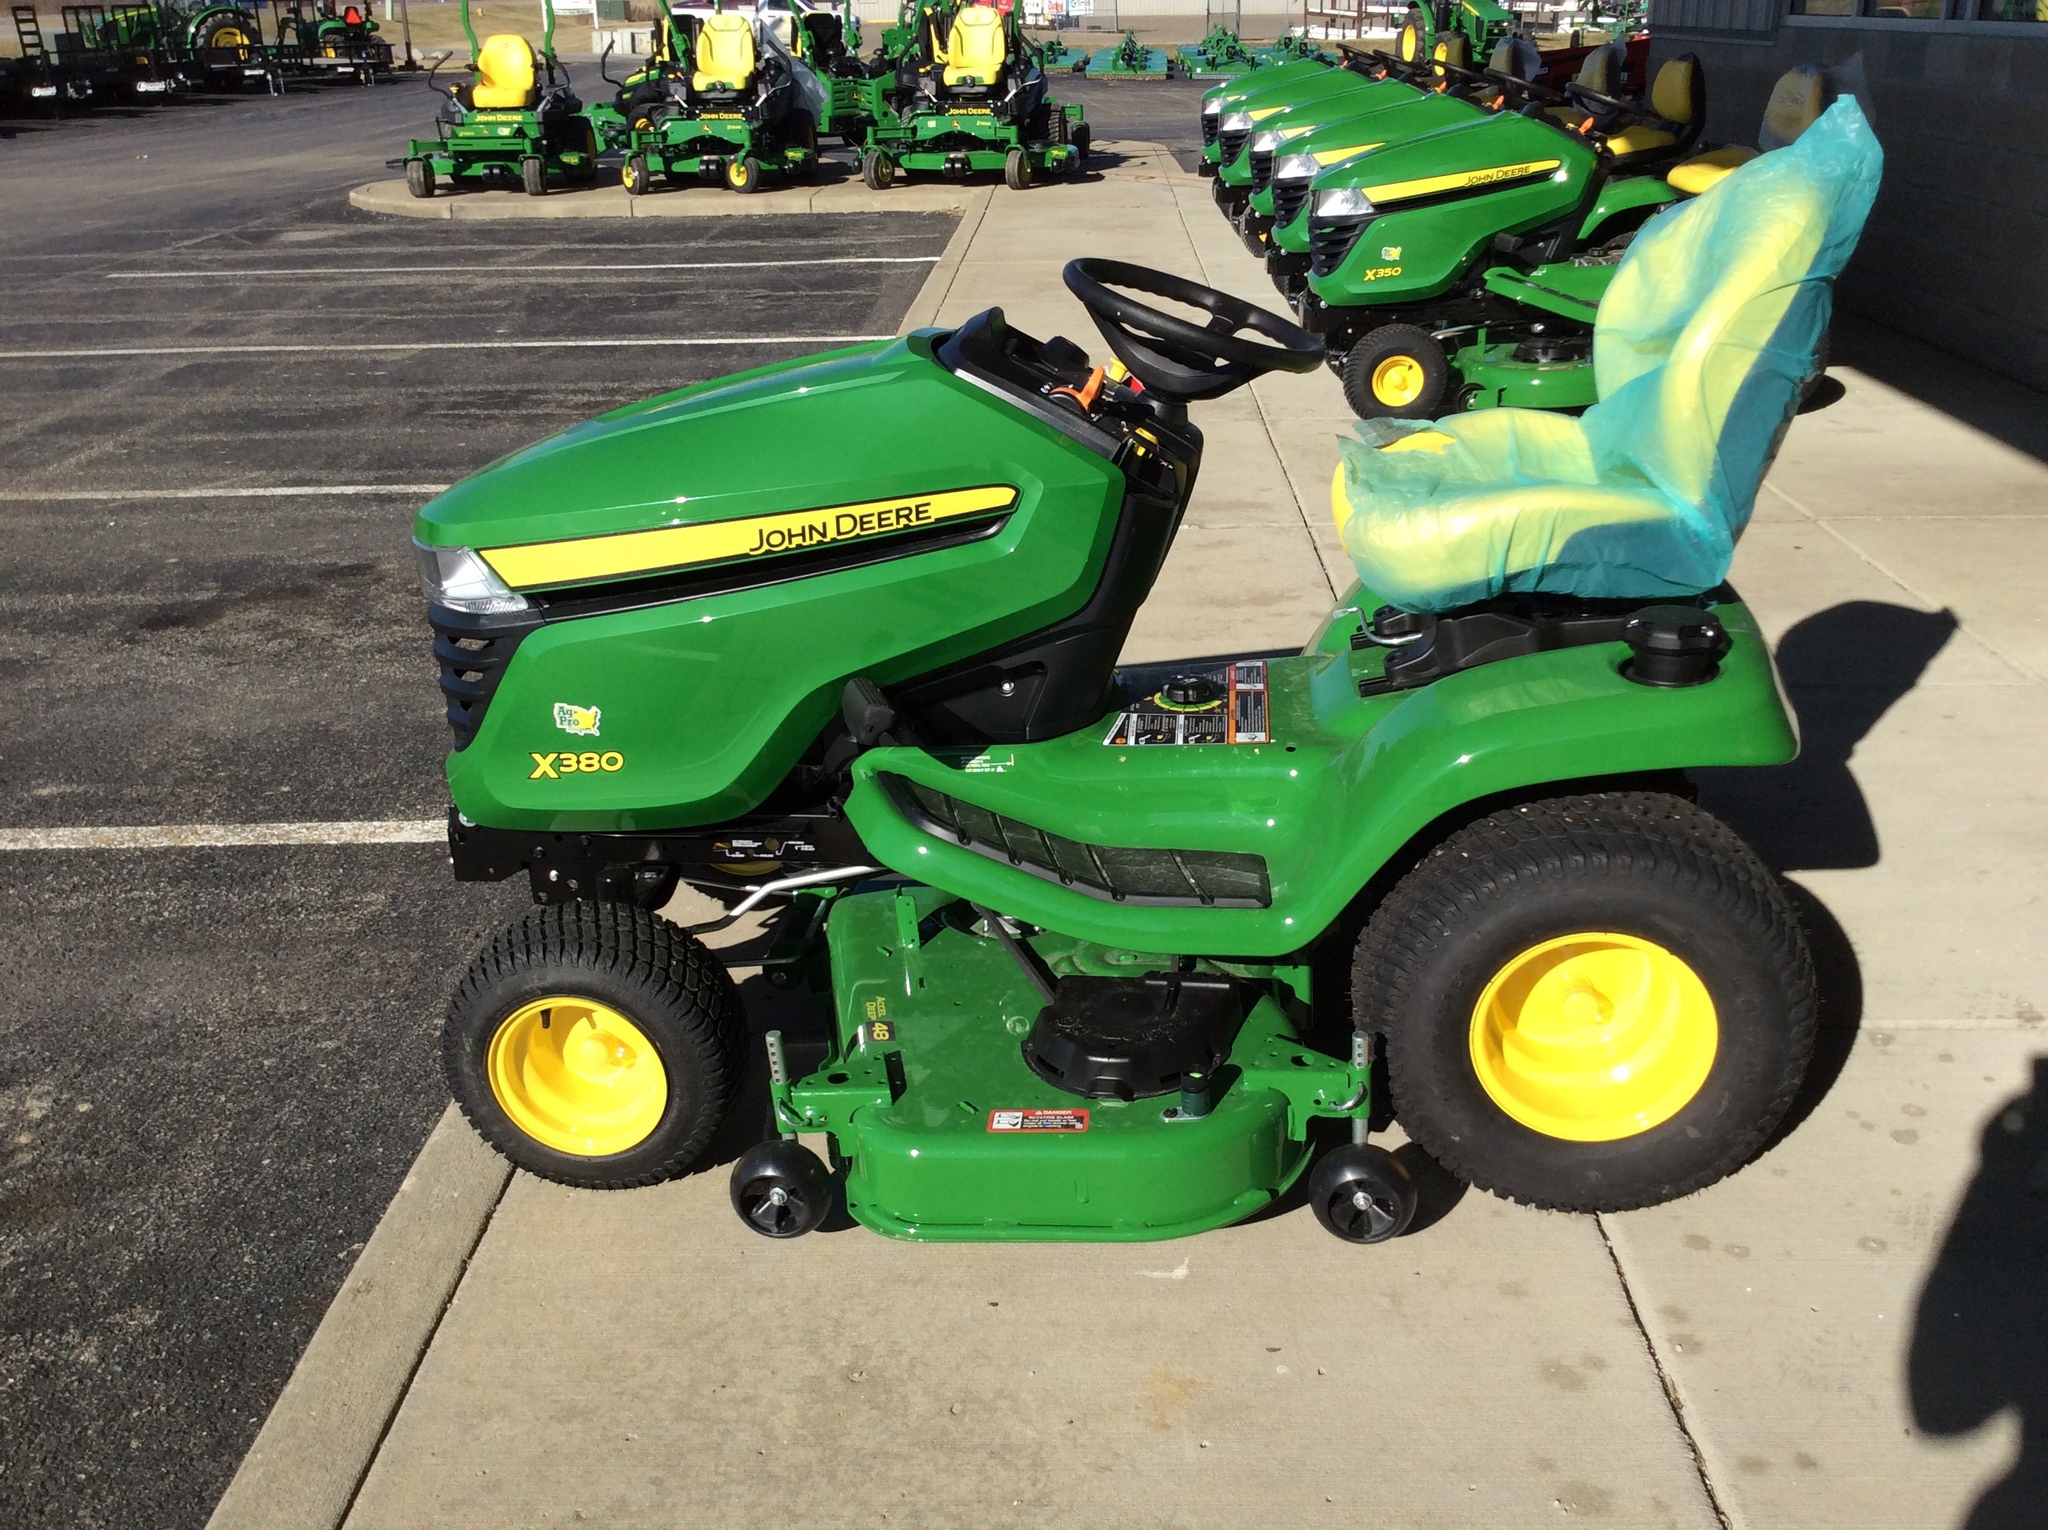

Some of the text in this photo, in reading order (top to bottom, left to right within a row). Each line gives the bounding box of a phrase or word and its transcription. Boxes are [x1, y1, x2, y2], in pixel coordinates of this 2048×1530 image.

[949, 107, 991, 115] JOHN DEERE
[1464, 165, 1531, 186] JOHN DEERE
[1363, 266, 1402, 282] X350
[749, 502, 932, 553] JOHN DEERE
[557, 706, 577, 718] Ag-
[559, 716, 580, 726] Pro
[527, 750, 625, 780] X380
[872, 1022, 890, 1040] 48
